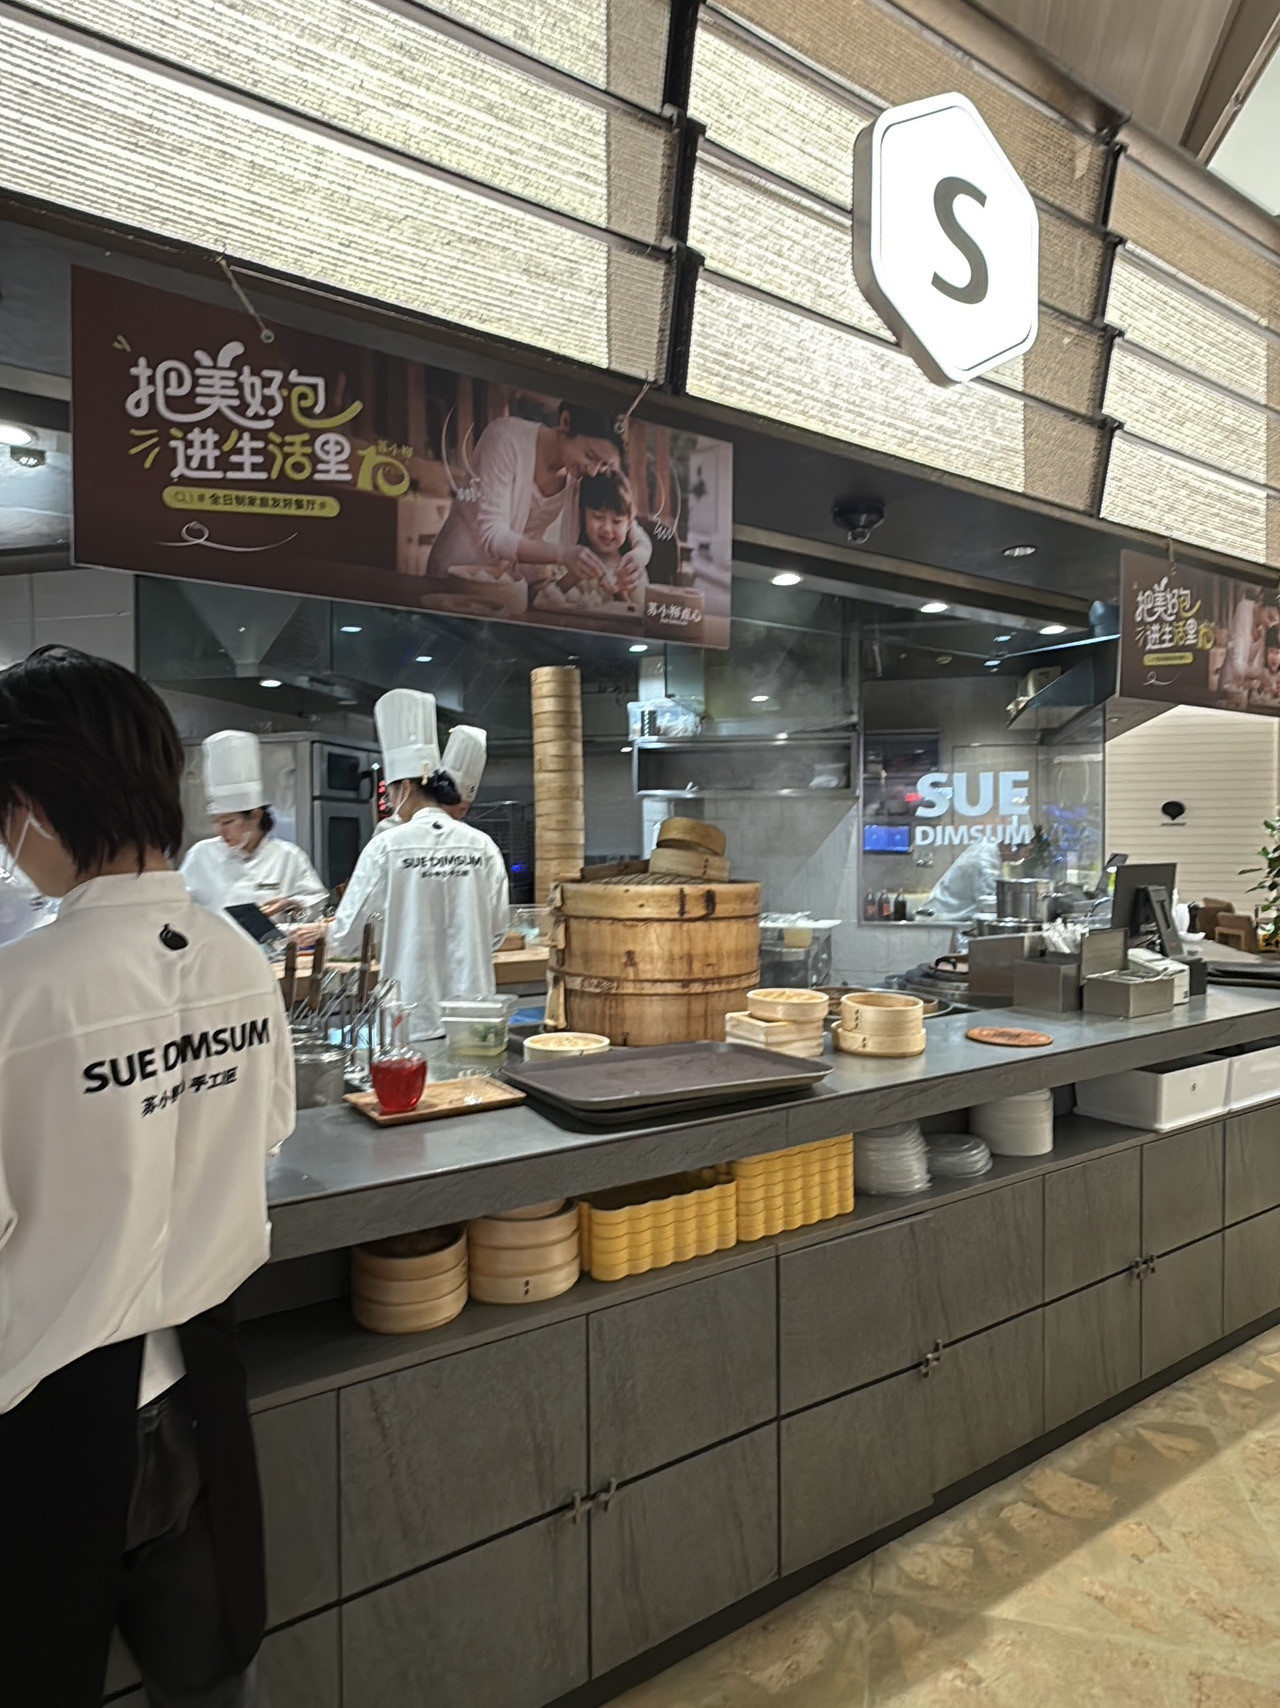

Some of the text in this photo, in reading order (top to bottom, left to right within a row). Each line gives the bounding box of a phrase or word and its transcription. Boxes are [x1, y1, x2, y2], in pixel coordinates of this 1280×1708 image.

[931, 176, 988, 304] S
[125, 341, 363, 429] 把美好包
[167, 427, 352, 482] 进生活里
[1134, 576, 1202, 622] 把美好包
[1145, 617, 1198, 651] 进生活里
[915, 771, 1030, 819] SUE
[915, 824, 1032, 847] DIMSUM
[83, 1047, 158, 1094] SUE
